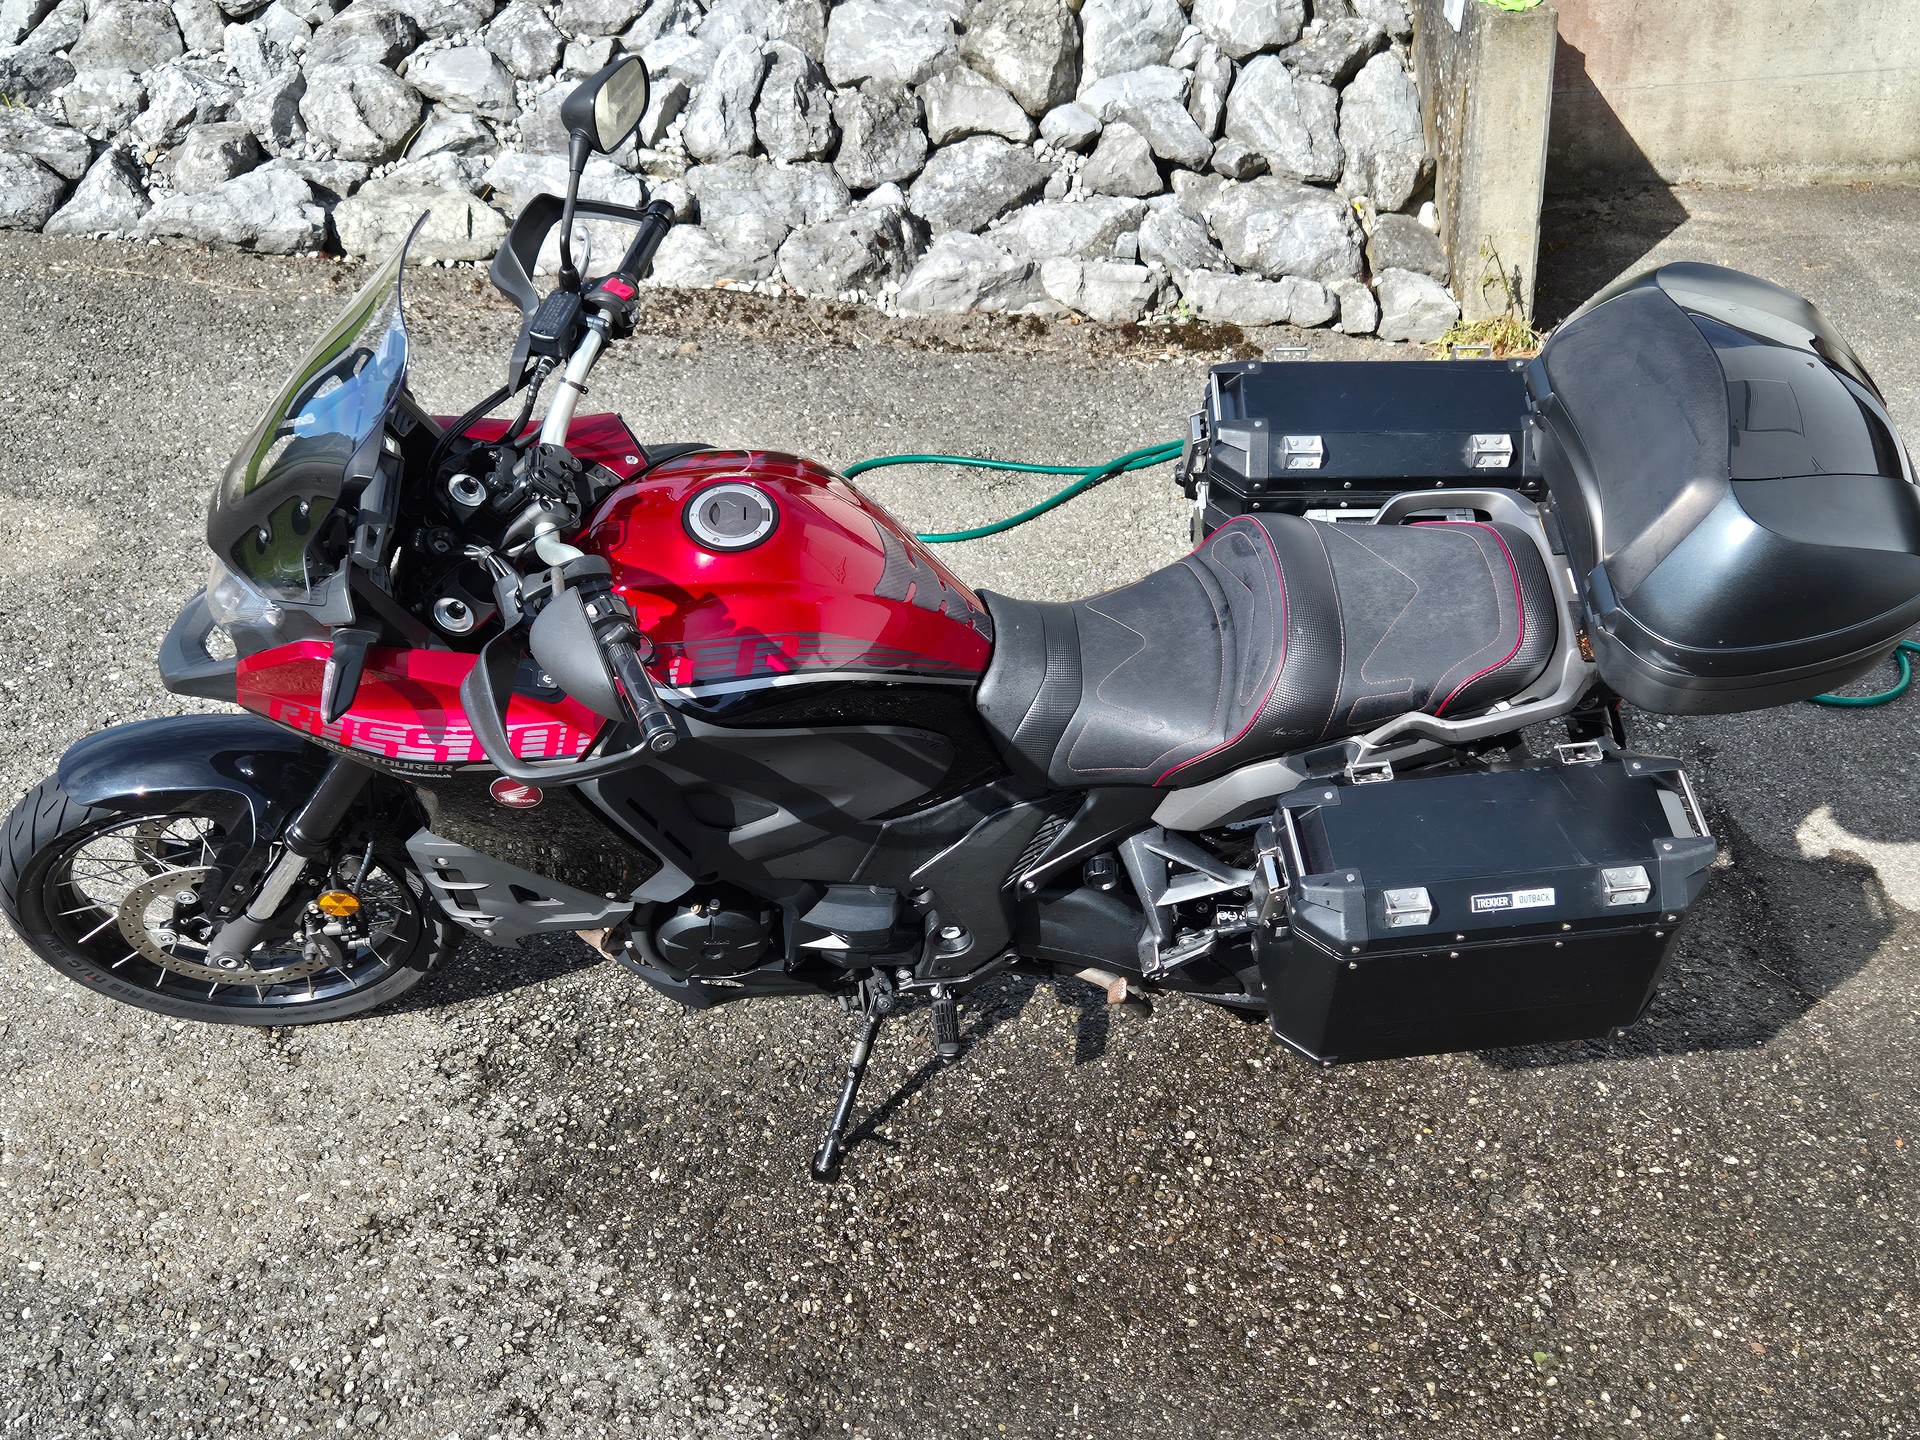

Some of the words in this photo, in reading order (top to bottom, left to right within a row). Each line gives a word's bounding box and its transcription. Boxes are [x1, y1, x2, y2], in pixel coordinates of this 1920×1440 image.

[311, 735, 454, 772] CROSSTOURER
[1476, 896, 1509, 909] TREKKER
[1519, 893, 1551, 904] OUTBACK
